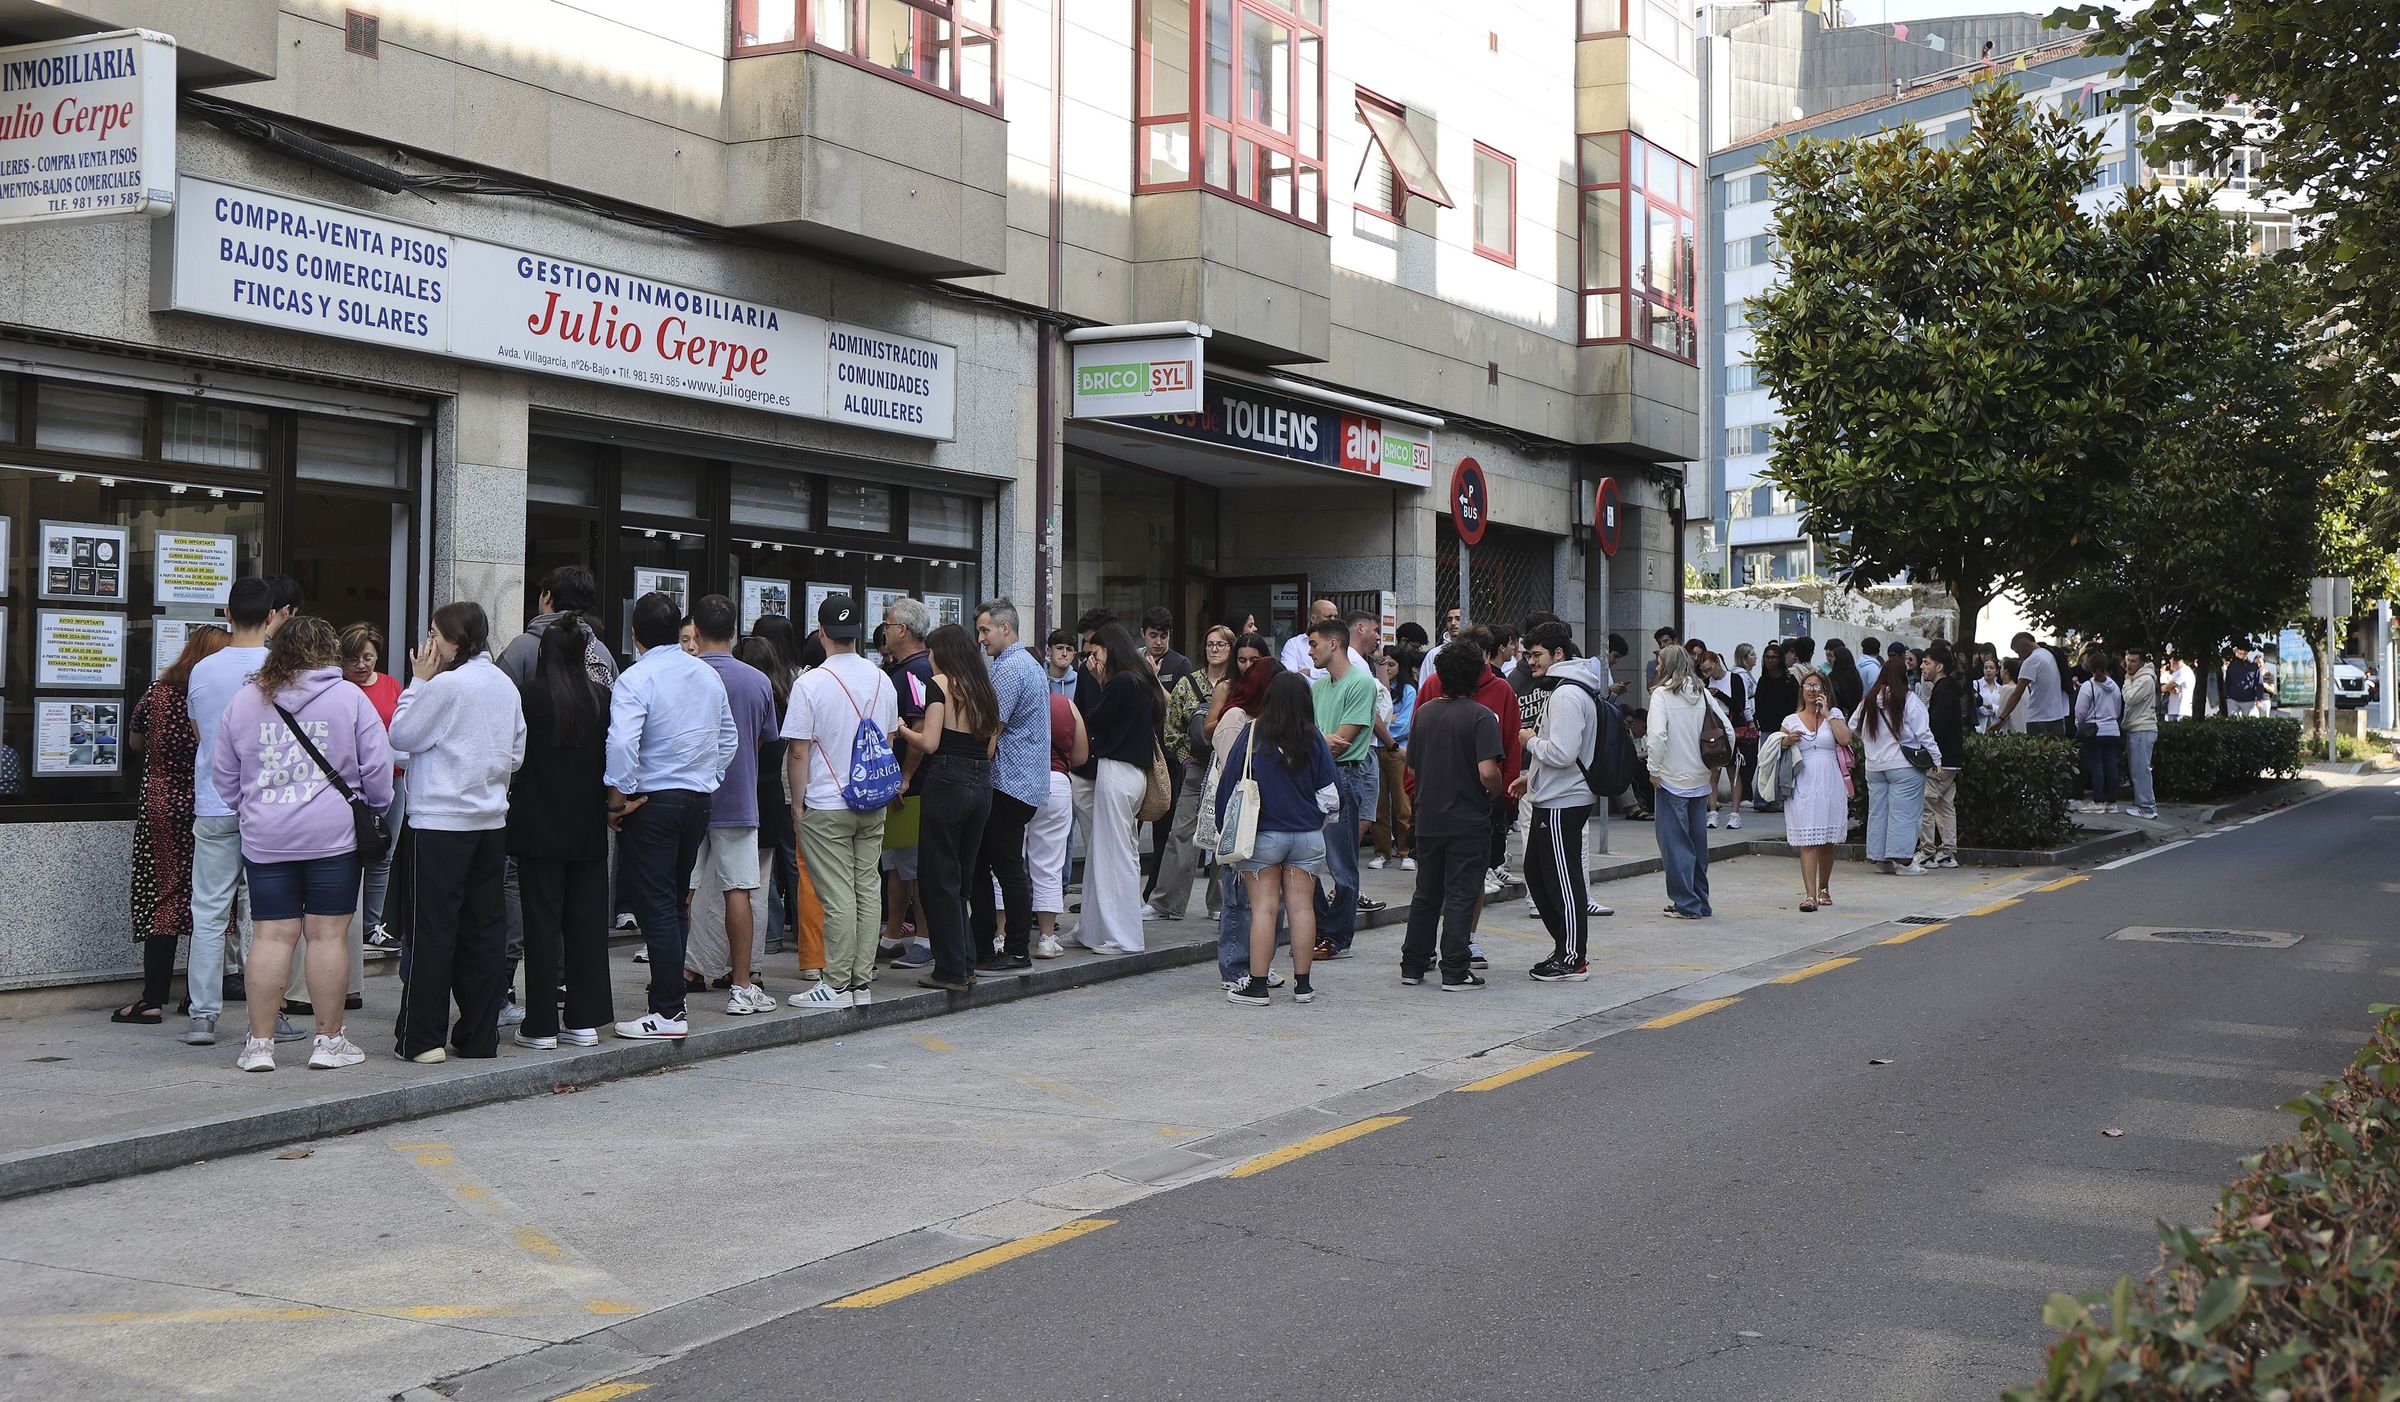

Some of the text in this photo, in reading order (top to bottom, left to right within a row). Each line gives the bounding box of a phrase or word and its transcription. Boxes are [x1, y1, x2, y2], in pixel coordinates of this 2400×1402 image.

[3, 47, 136, 92] INMOBILIARIA
[0, 97, 134, 141] ulio Gerpe
[0, 147, 137, 177] LERES COMPRA VENTA PISOS
[75, 170, 141, 192] COMERCIALES
[48, 199, 68, 211] TLF.
[72, 197, 92, 210] 981
[97, 194, 116, 207] 591
[120, 192, 140, 205] 585
[215, 197, 448, 269] COMPRA-VENTA PISOS
[220, 237, 441, 304] BAJOS COMERCIALES
[233, 278, 428, 337] FINCAS Y SOLARES
[517, 256, 779, 332] GESTION INMOBILIARIA
[527, 290, 768, 381] Julio Gerpe
[829, 331, 938, 370] ADMINISTRACION
[498, 345, 521, 359] Avda.
[618, 367, 631, 380] Tlf.
[633, 368, 647, 382] 981
[649, 372, 664, 385] 591
[665, 374, 680, 387] 585
[687, 378, 791, 408] www.juliogerpe.es
[838, 362, 929, 397] COMUNIDADES
[1082, 367, 1184, 391] BRICO SYL
[844, 393, 923, 424] ALQUILERES
[1222, 396, 1318, 452] TOLLENS
[1346, 419, 1380, 471] alp
[1384, 442, 1427, 466] BRICO SYL
[1468, 485, 1474, 498] P
[1463, 505, 1478, 520] BUS
[1518, 688, 1547, 706] cuffe
[258, 721, 329, 746] HAVE
[282, 745, 303, 767] A
[869, 762, 901, 781] ZURICH
[260, 781, 320, 804] DAY
[641, 1020, 658, 1032] N
